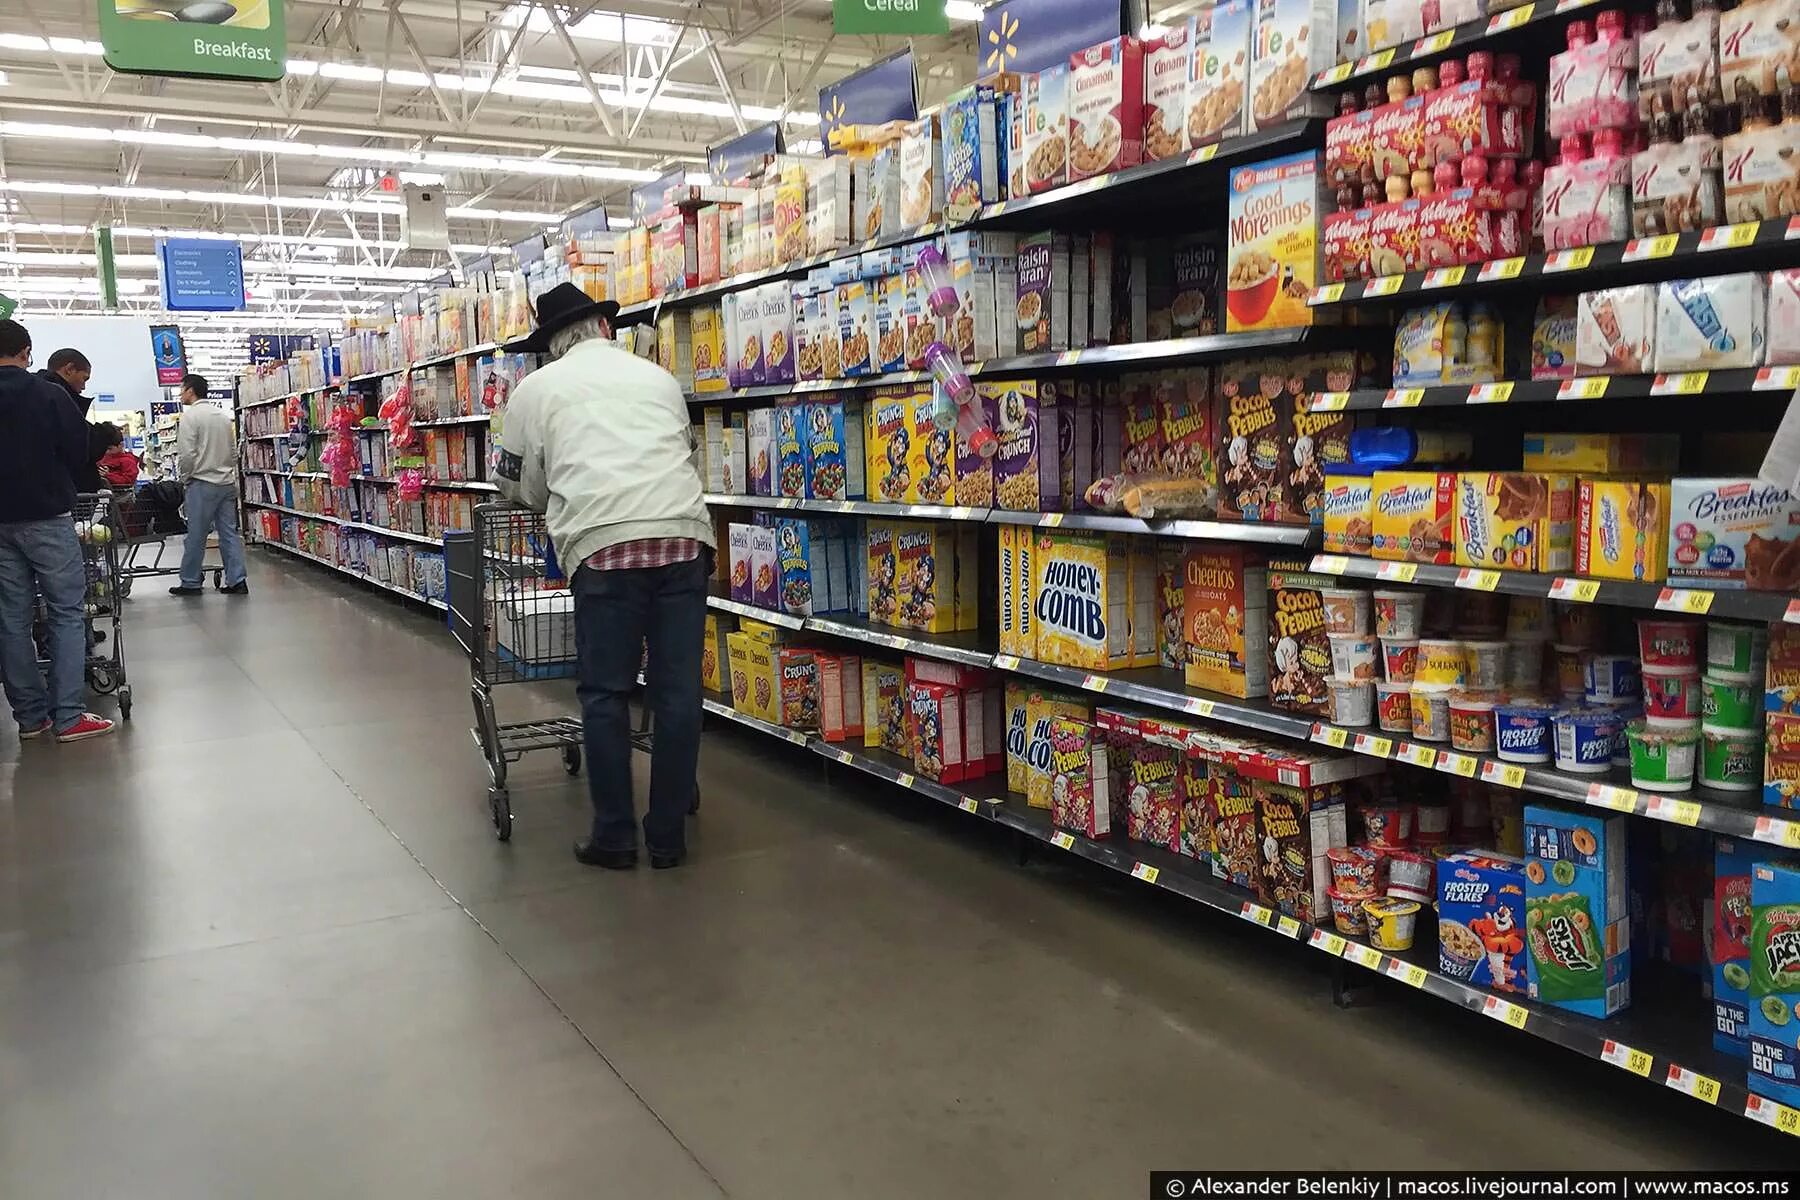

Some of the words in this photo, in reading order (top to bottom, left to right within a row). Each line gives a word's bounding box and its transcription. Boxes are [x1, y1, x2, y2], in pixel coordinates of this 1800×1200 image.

[864, 0, 919, 11] Cereal
[194, 39, 272, 61] Breakfast
[1724, 22, 1753, 57] K
[1642, 42, 1666, 76] K
[1076, 69, 1114, 94] Cinnamon
[1552, 65, 1576, 104] K
[1729, 147, 1754, 182] K
[1636, 164, 1658, 196] K
[1244, 184, 1283, 218] Good
[1546, 179, 1573, 216] K
[1231, 200, 1312, 248] Morenings
[1276, 231, 1299, 247] waffle
[1285, 237, 1312, 254] crunch
[1018, 247, 1049, 271] Raisin
[1175, 247, 1216, 268] Raisin
[1020, 265, 1044, 286] Bran
[1178, 264, 1209, 282] Bran
[877, 404, 905, 427] CRUNCH
[915, 403, 934, 425] CRUN
[1230, 394, 1271, 416] COCOA
[1126, 418, 1157, 444] PEBB
[1162, 413, 1204, 443] PEBBLES
[1228, 407, 1277, 437] PEBBLES
[998, 438, 1031, 459] CRUNCH
[1378, 487, 1434, 514] Breakfast
[1582, 485, 1591, 500] 22
[1688, 485, 1790, 519] Breakfas
[1387, 505, 1424, 517] ESSENTIALS
[1464, 477, 1485, 567] Breakfast
[1580, 503, 1590, 528] PACK
[1713, 505, 1782, 524] ESSENTIALS
[869, 529, 893, 546] CRUNCH
[897, 530, 932, 550] CRUNCH
[1578, 529, 1590, 572] VALUE
[1187, 559, 1235, 590] Cheerios
[1269, 561, 1306, 572] FAMILY
[1286, 577, 1309, 585] LIMITED
[1310, 578, 1334, 588] EDITION
[1276, 590, 1321, 613] COCOA
[784, 663, 816, 680] CRUNC
[911, 699, 938, 715] CRUNCH
[1501, 727, 1546, 740] FROSTED
[1503, 735, 1539, 748] FLAKES
[1053, 750, 1088, 773] PEBBLES
[1133, 759, 1174, 784] PEBBLES
[1184, 774, 1209, 798] PEBB
[1263, 800, 1295, 819] COCOA
[1263, 816, 1300, 839] PEBBLES
[1333, 866, 1362, 876] CRUNCH
[1444, 882, 1490, 894] FROSTED
[1445, 891, 1484, 903] FLAKES
[1552, 916, 1598, 971] JACKS
[1716, 1004, 1727, 1017] ON
[1728, 1008, 1745, 1023] THE
[1717, 1016, 1736, 1036] GO
[1752, 1041, 1765, 1055] ON
[1765, 1046, 1784, 1061] THE
[1752, 1053, 1773, 1074] GO
[1780, 1109, 1798, 1129] $3.38
